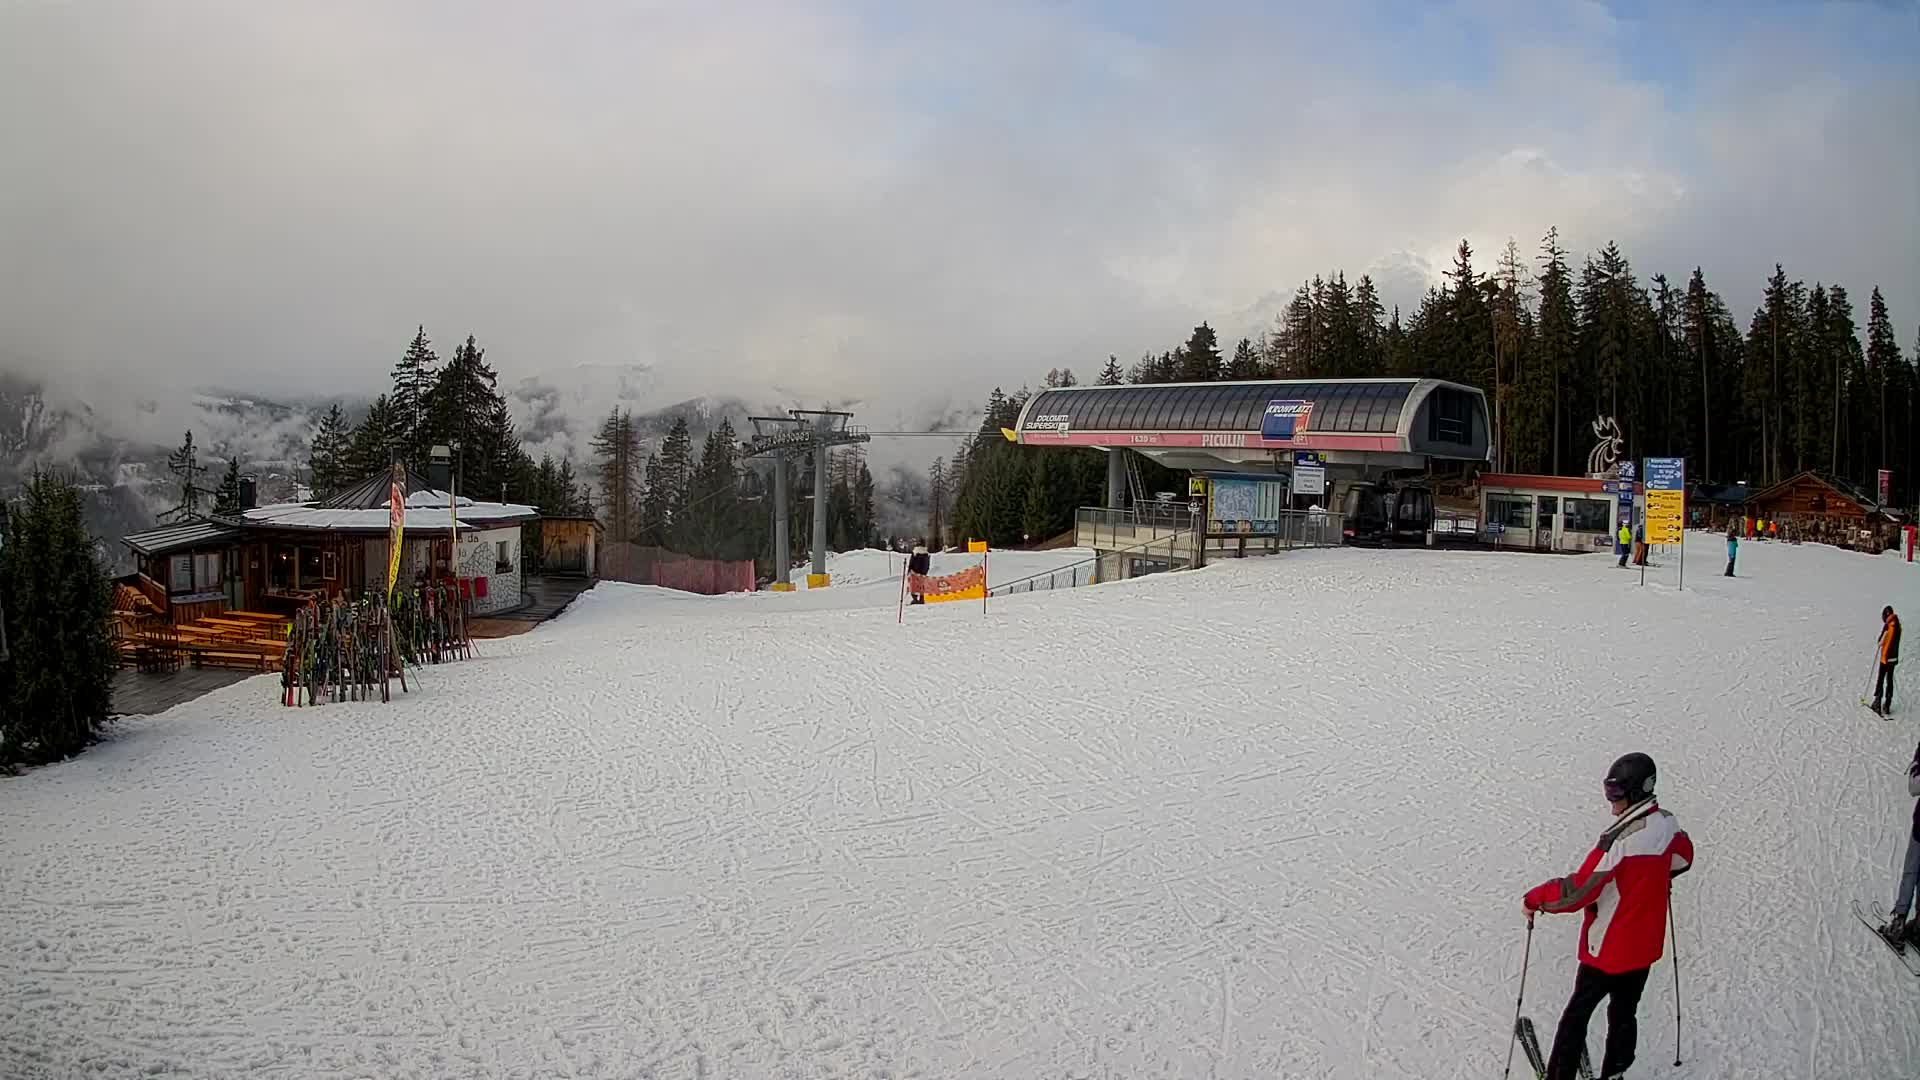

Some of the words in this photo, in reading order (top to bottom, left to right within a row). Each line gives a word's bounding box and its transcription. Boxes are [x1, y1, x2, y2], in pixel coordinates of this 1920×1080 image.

[1266, 405, 1312, 413] KRONPLATZ
[1036, 414, 1069, 422] DOLOMITI
[1025, 422, 1059, 430] SUPERSKI
[1202, 433, 1246, 448] PICULIN
